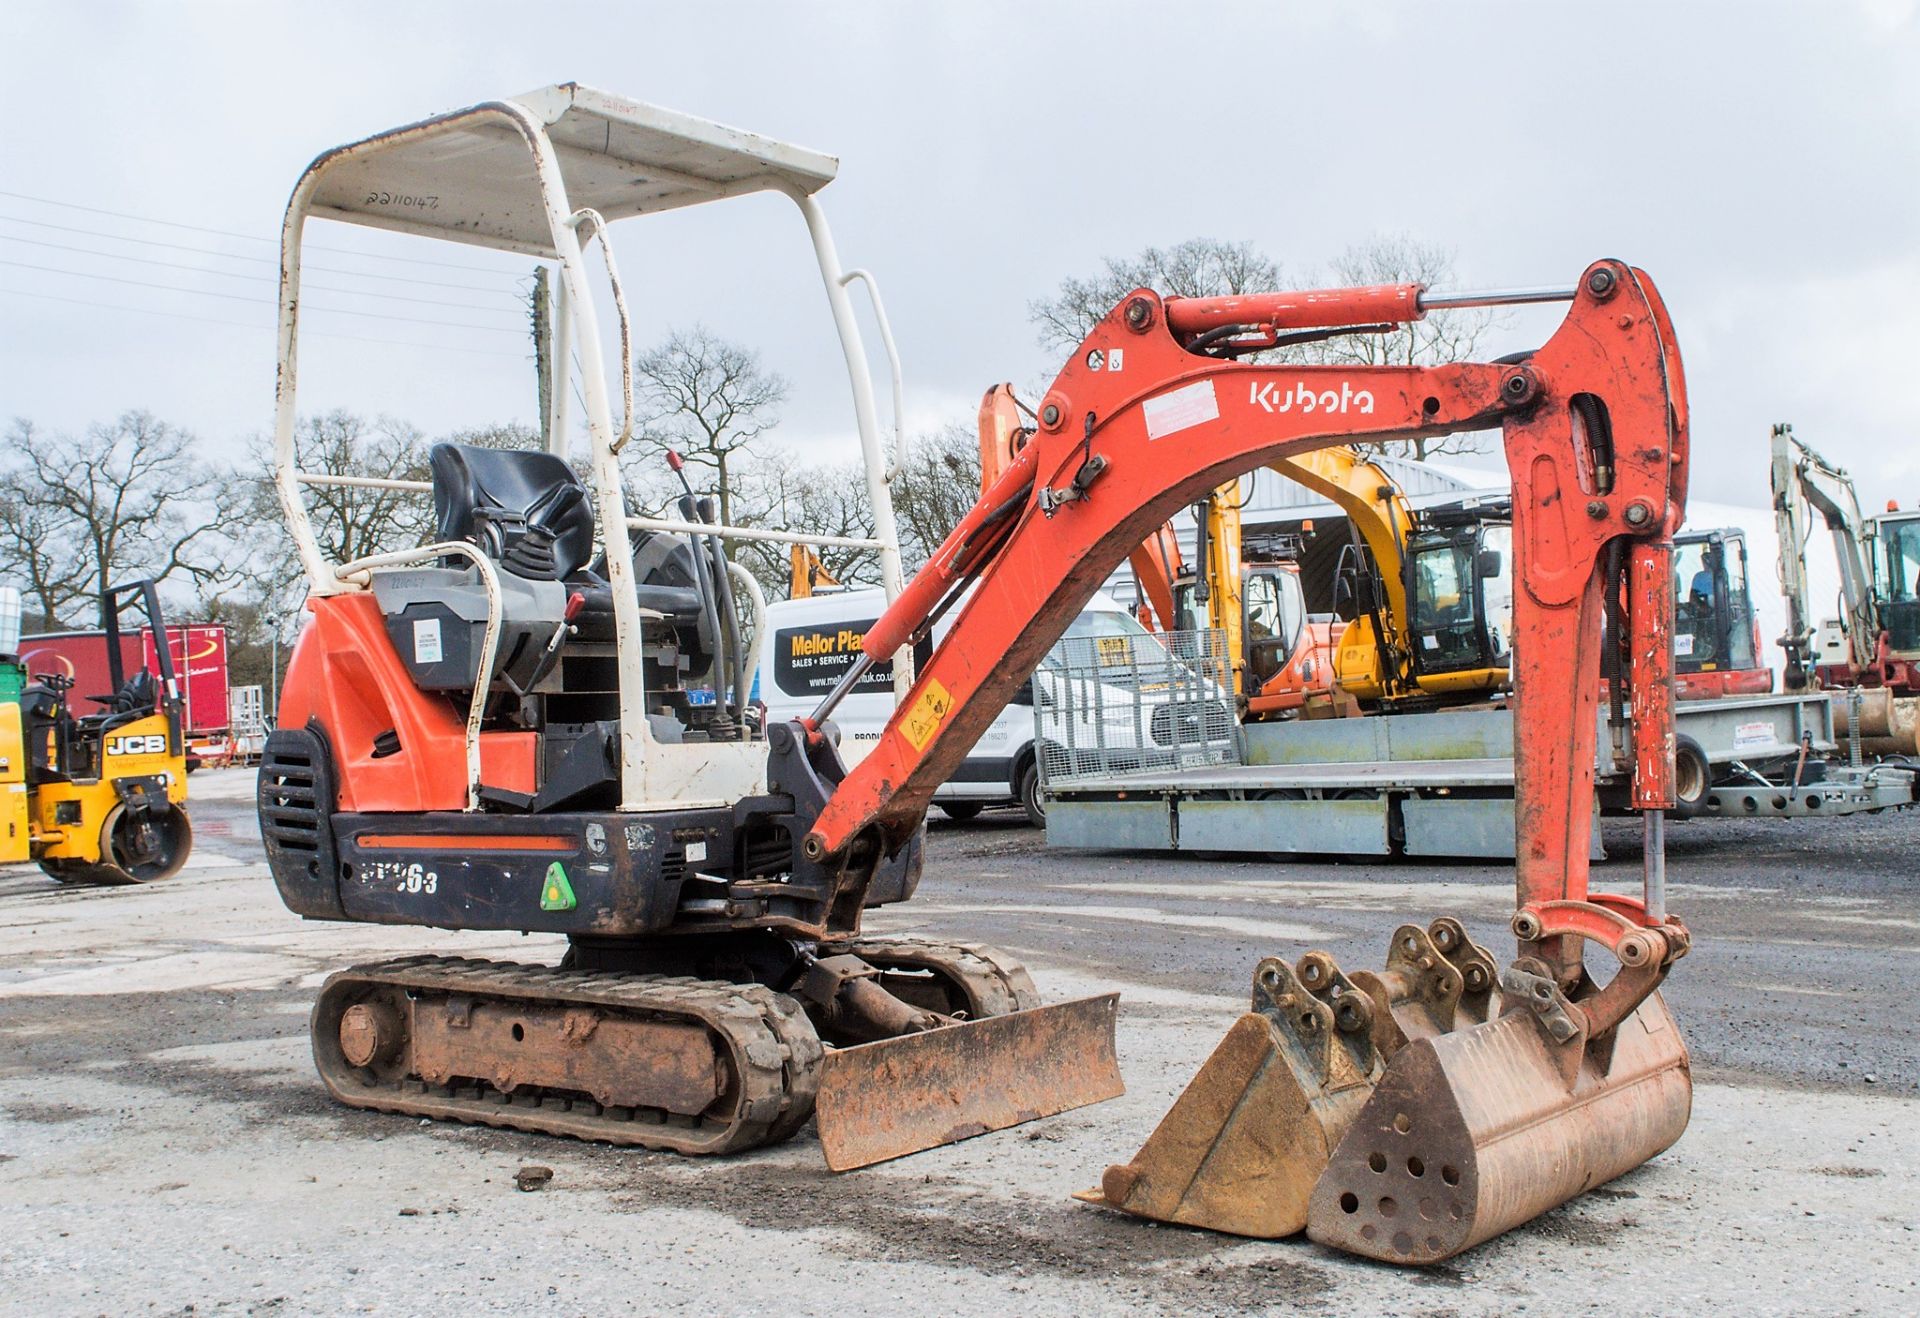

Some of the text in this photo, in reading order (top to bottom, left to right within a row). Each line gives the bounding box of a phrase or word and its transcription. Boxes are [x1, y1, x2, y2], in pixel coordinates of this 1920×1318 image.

[1250, 381, 1374, 414] Kubota
[792, 630, 865, 656] Mellor Pla
[791, 657, 813, 668] SALES
[819, 654, 849, 666] SERVICE
[106, 735, 165, 755] JCB
